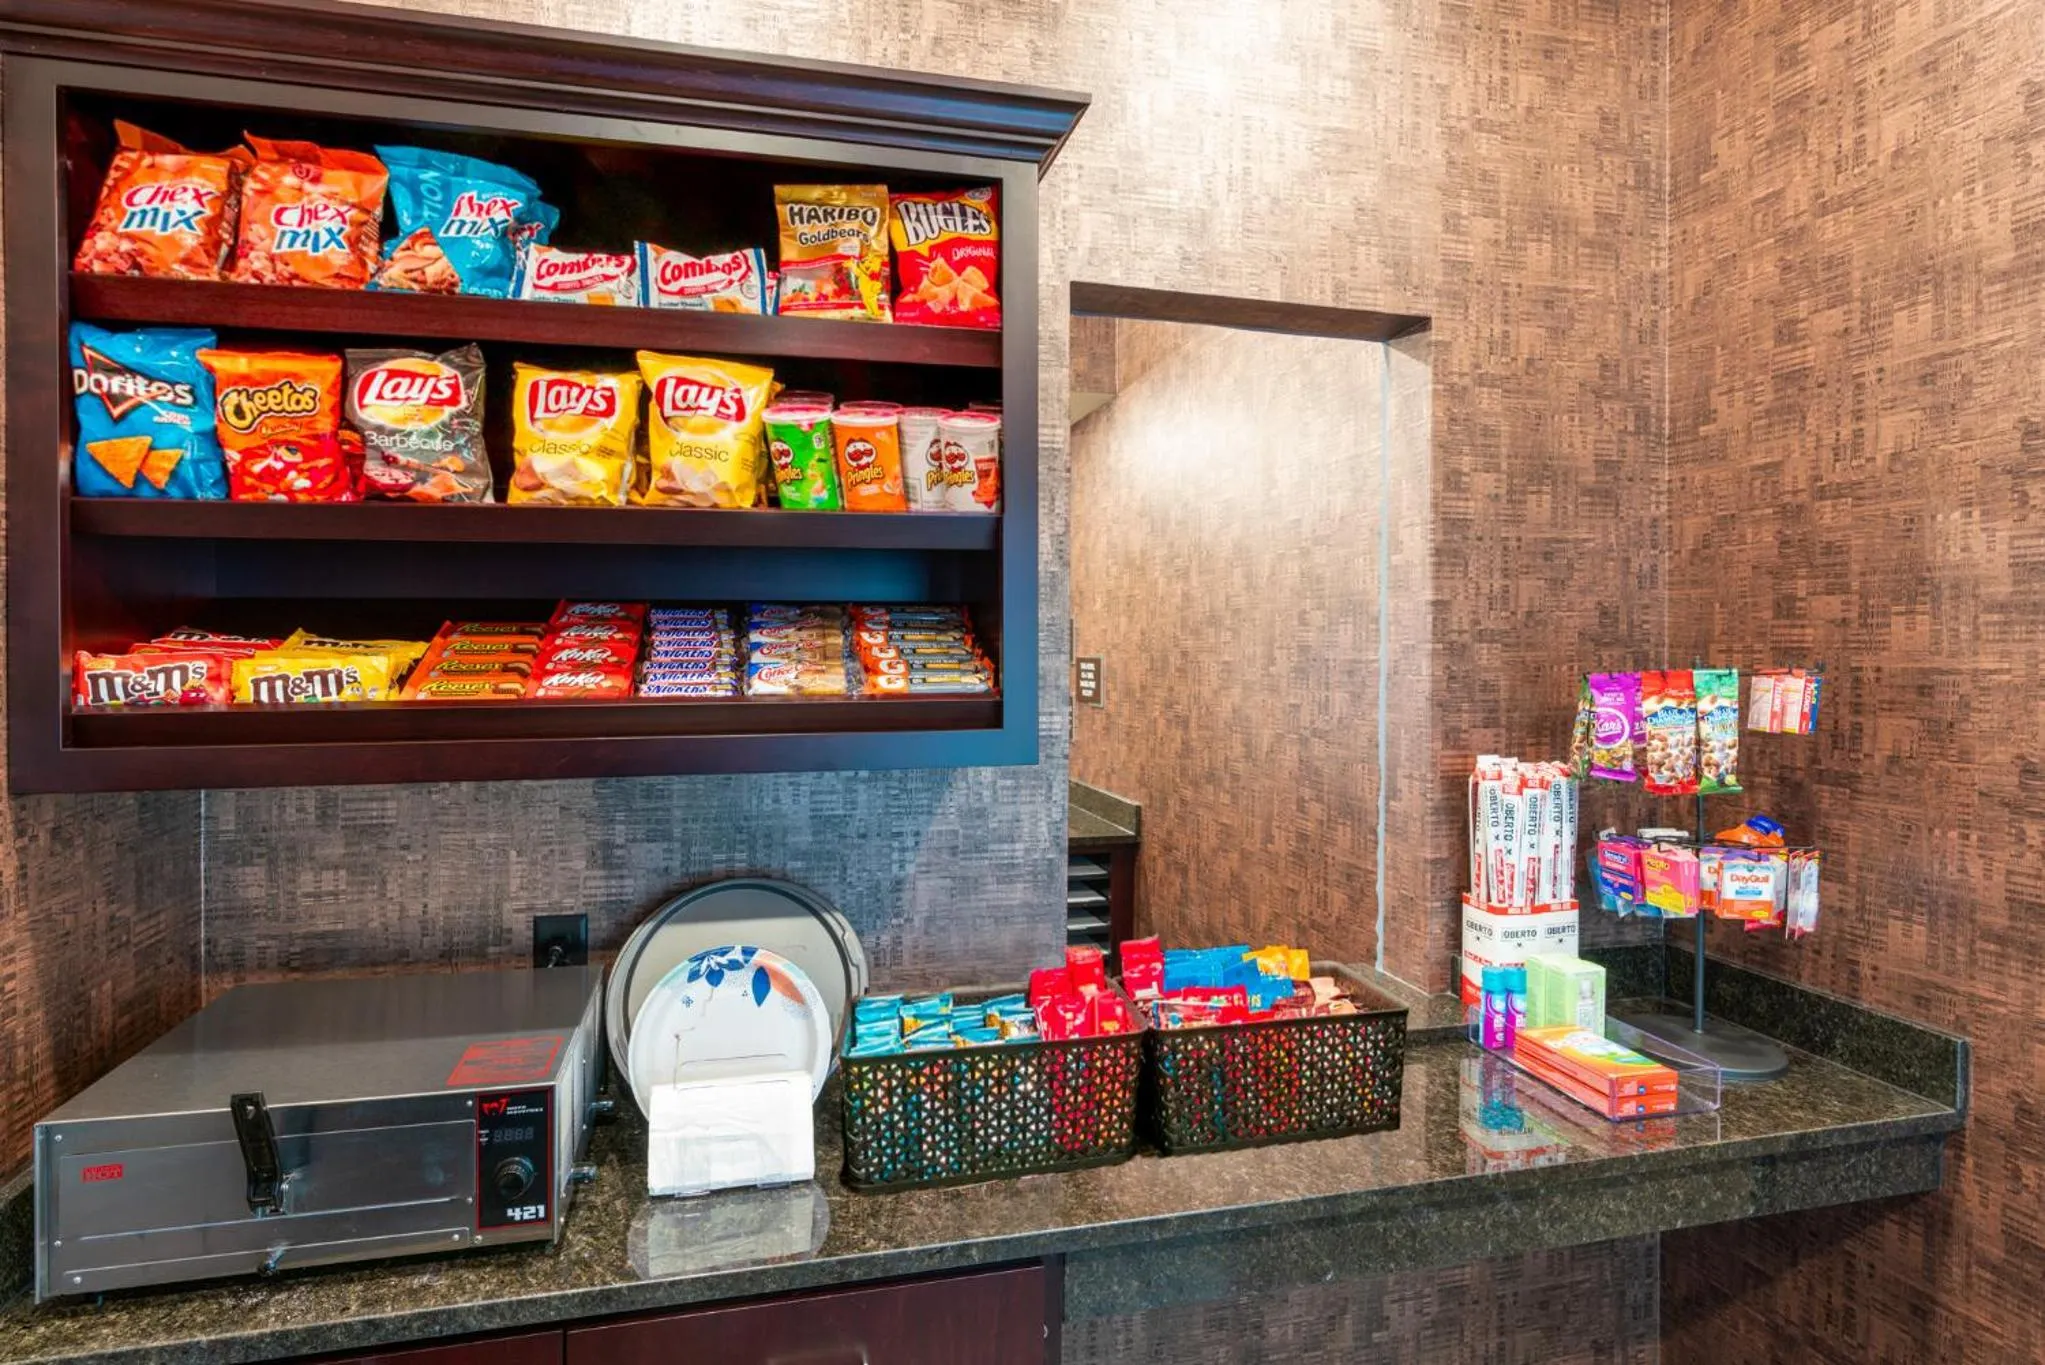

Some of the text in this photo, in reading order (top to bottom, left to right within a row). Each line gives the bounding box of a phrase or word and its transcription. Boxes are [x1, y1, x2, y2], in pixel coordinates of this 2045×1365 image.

[122, 183, 216, 209] Chex
[120, 206, 205, 234] mix
[273, 202, 353, 227] Chex
[443, 217, 509, 237] mix
[789, 204, 877, 227] HARIBO
[897, 201, 992, 246] BUGLES
[275, 225, 349, 254] mix
[799, 228, 869, 245] Goldbears
[952, 246, 995, 260] ORIGINAL
[660, 255, 742, 285] Combos
[73, 368, 194, 406] Doritos
[534, 379, 612, 419] Lay's
[664, 378, 743, 419] Lay's
[221, 381, 317, 430] Cheetos
[848, 465, 883, 489] Pringles
[1489, 788, 1500, 828] OBERTO
[1528, 796, 1539, 836] OBERTO
[1553, 784, 1562, 823] OBERTO
[1504, 803, 1516, 841] OBERTO
[1466, 919, 1494, 936] OBERTO
[1503, 929, 1537, 939] OBERTO
[1547, 924, 1576, 935] OBERTO
[506, 1204, 545, 1221] 421
